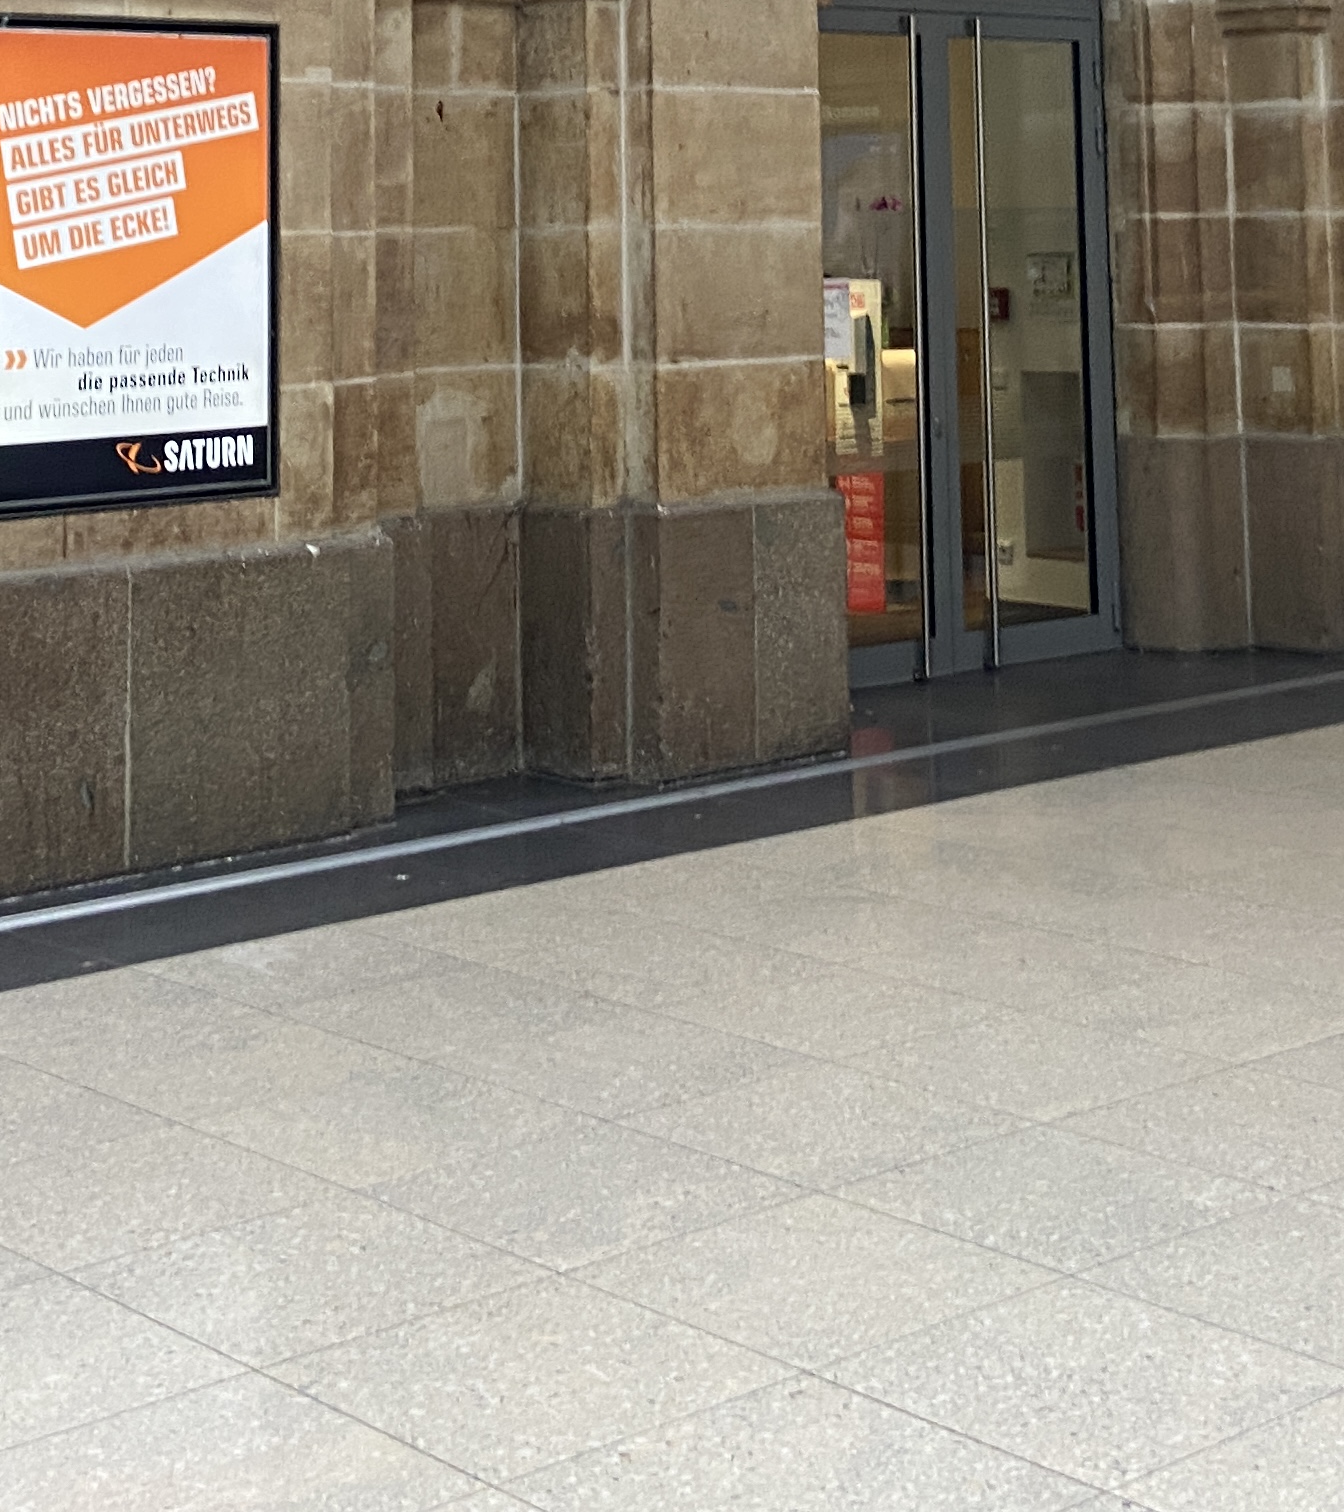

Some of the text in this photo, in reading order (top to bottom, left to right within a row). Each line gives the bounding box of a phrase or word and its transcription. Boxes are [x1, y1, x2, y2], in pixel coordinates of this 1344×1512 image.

[86, 65, 217, 117] VERGESSEN?
[10, 100, 252, 172] ALLES FÜR UNTERWEGS
[15, 159, 179, 216] GIBT ES GLEICH
[22, 205, 170, 261] UM DIE ECKE!
[33, 342, 184, 369] Wir haben für jeden
[78, 362, 249, 394] die passende Technik
[3, 387, 244, 421] und wünschen Ihnen gute Reise.
[163, 433, 255, 473] SATURN
